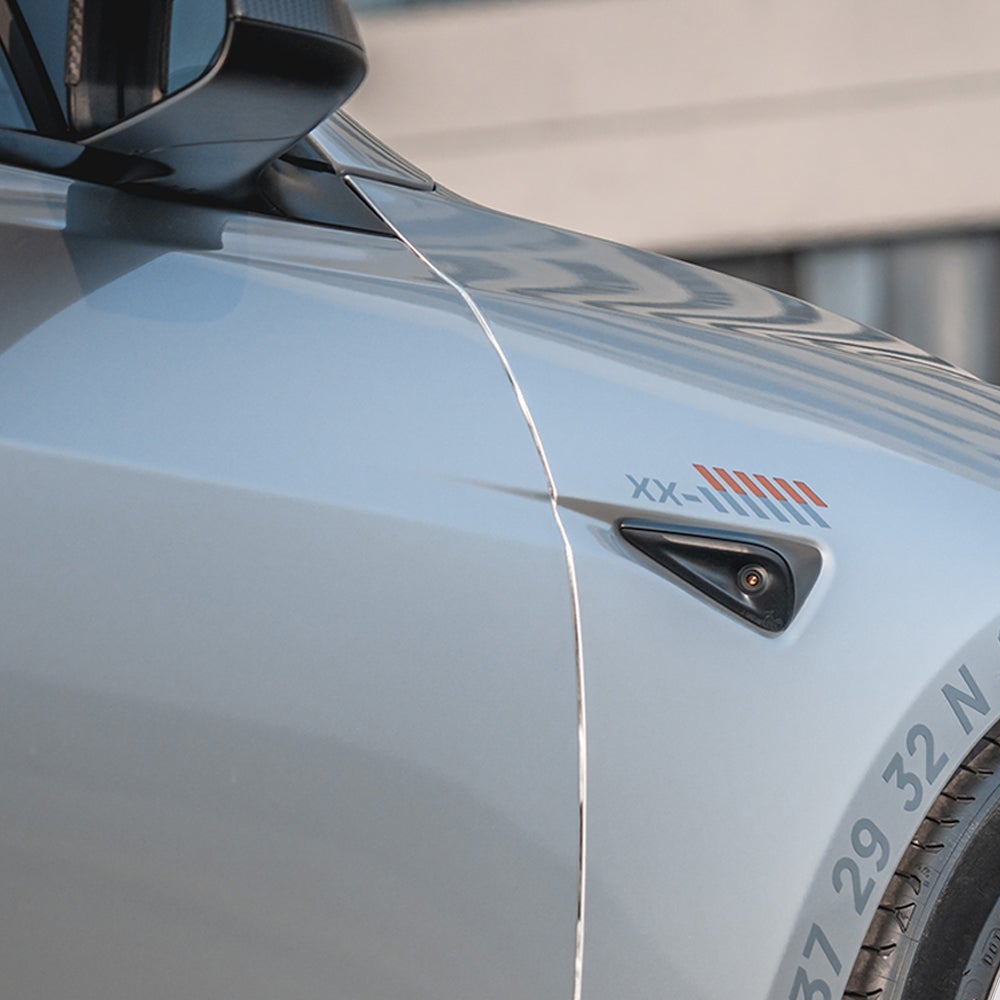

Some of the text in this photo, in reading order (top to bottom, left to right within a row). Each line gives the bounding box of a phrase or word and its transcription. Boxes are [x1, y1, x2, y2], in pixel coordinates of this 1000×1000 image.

[831, 817, 891, 916] 29
[881, 723, 949, 813] 32
[941, 664, 991, 735] N
